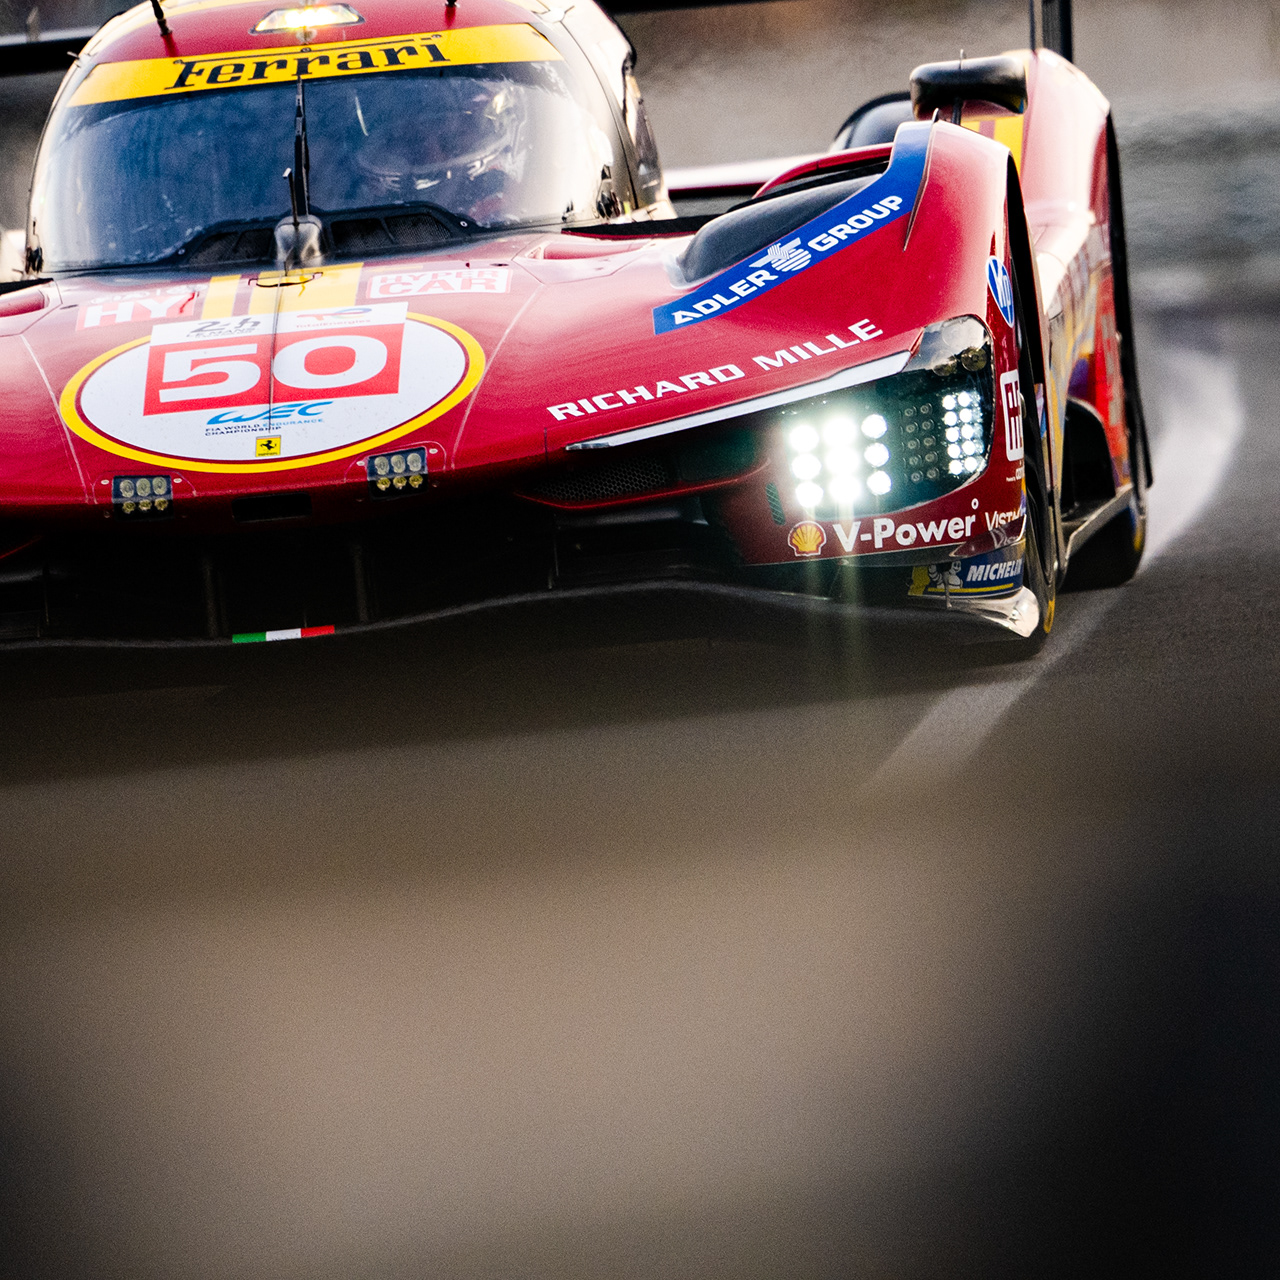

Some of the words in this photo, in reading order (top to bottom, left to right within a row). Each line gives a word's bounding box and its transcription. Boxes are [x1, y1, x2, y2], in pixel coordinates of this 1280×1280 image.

[163, 36, 451, 91] Ferrari
[379, 269, 500, 284] HYPER
[670, 269, 779, 325] ADLER
[807, 195, 903, 252] GROUP
[378, 278, 498, 295] CAR
[159, 335, 388, 404] 50
[546, 364, 746, 422] RICHARD
[752, 318, 884, 371] MILLE
[206, 401, 334, 425] WEC
[832, 514, 977, 553] V-Power
